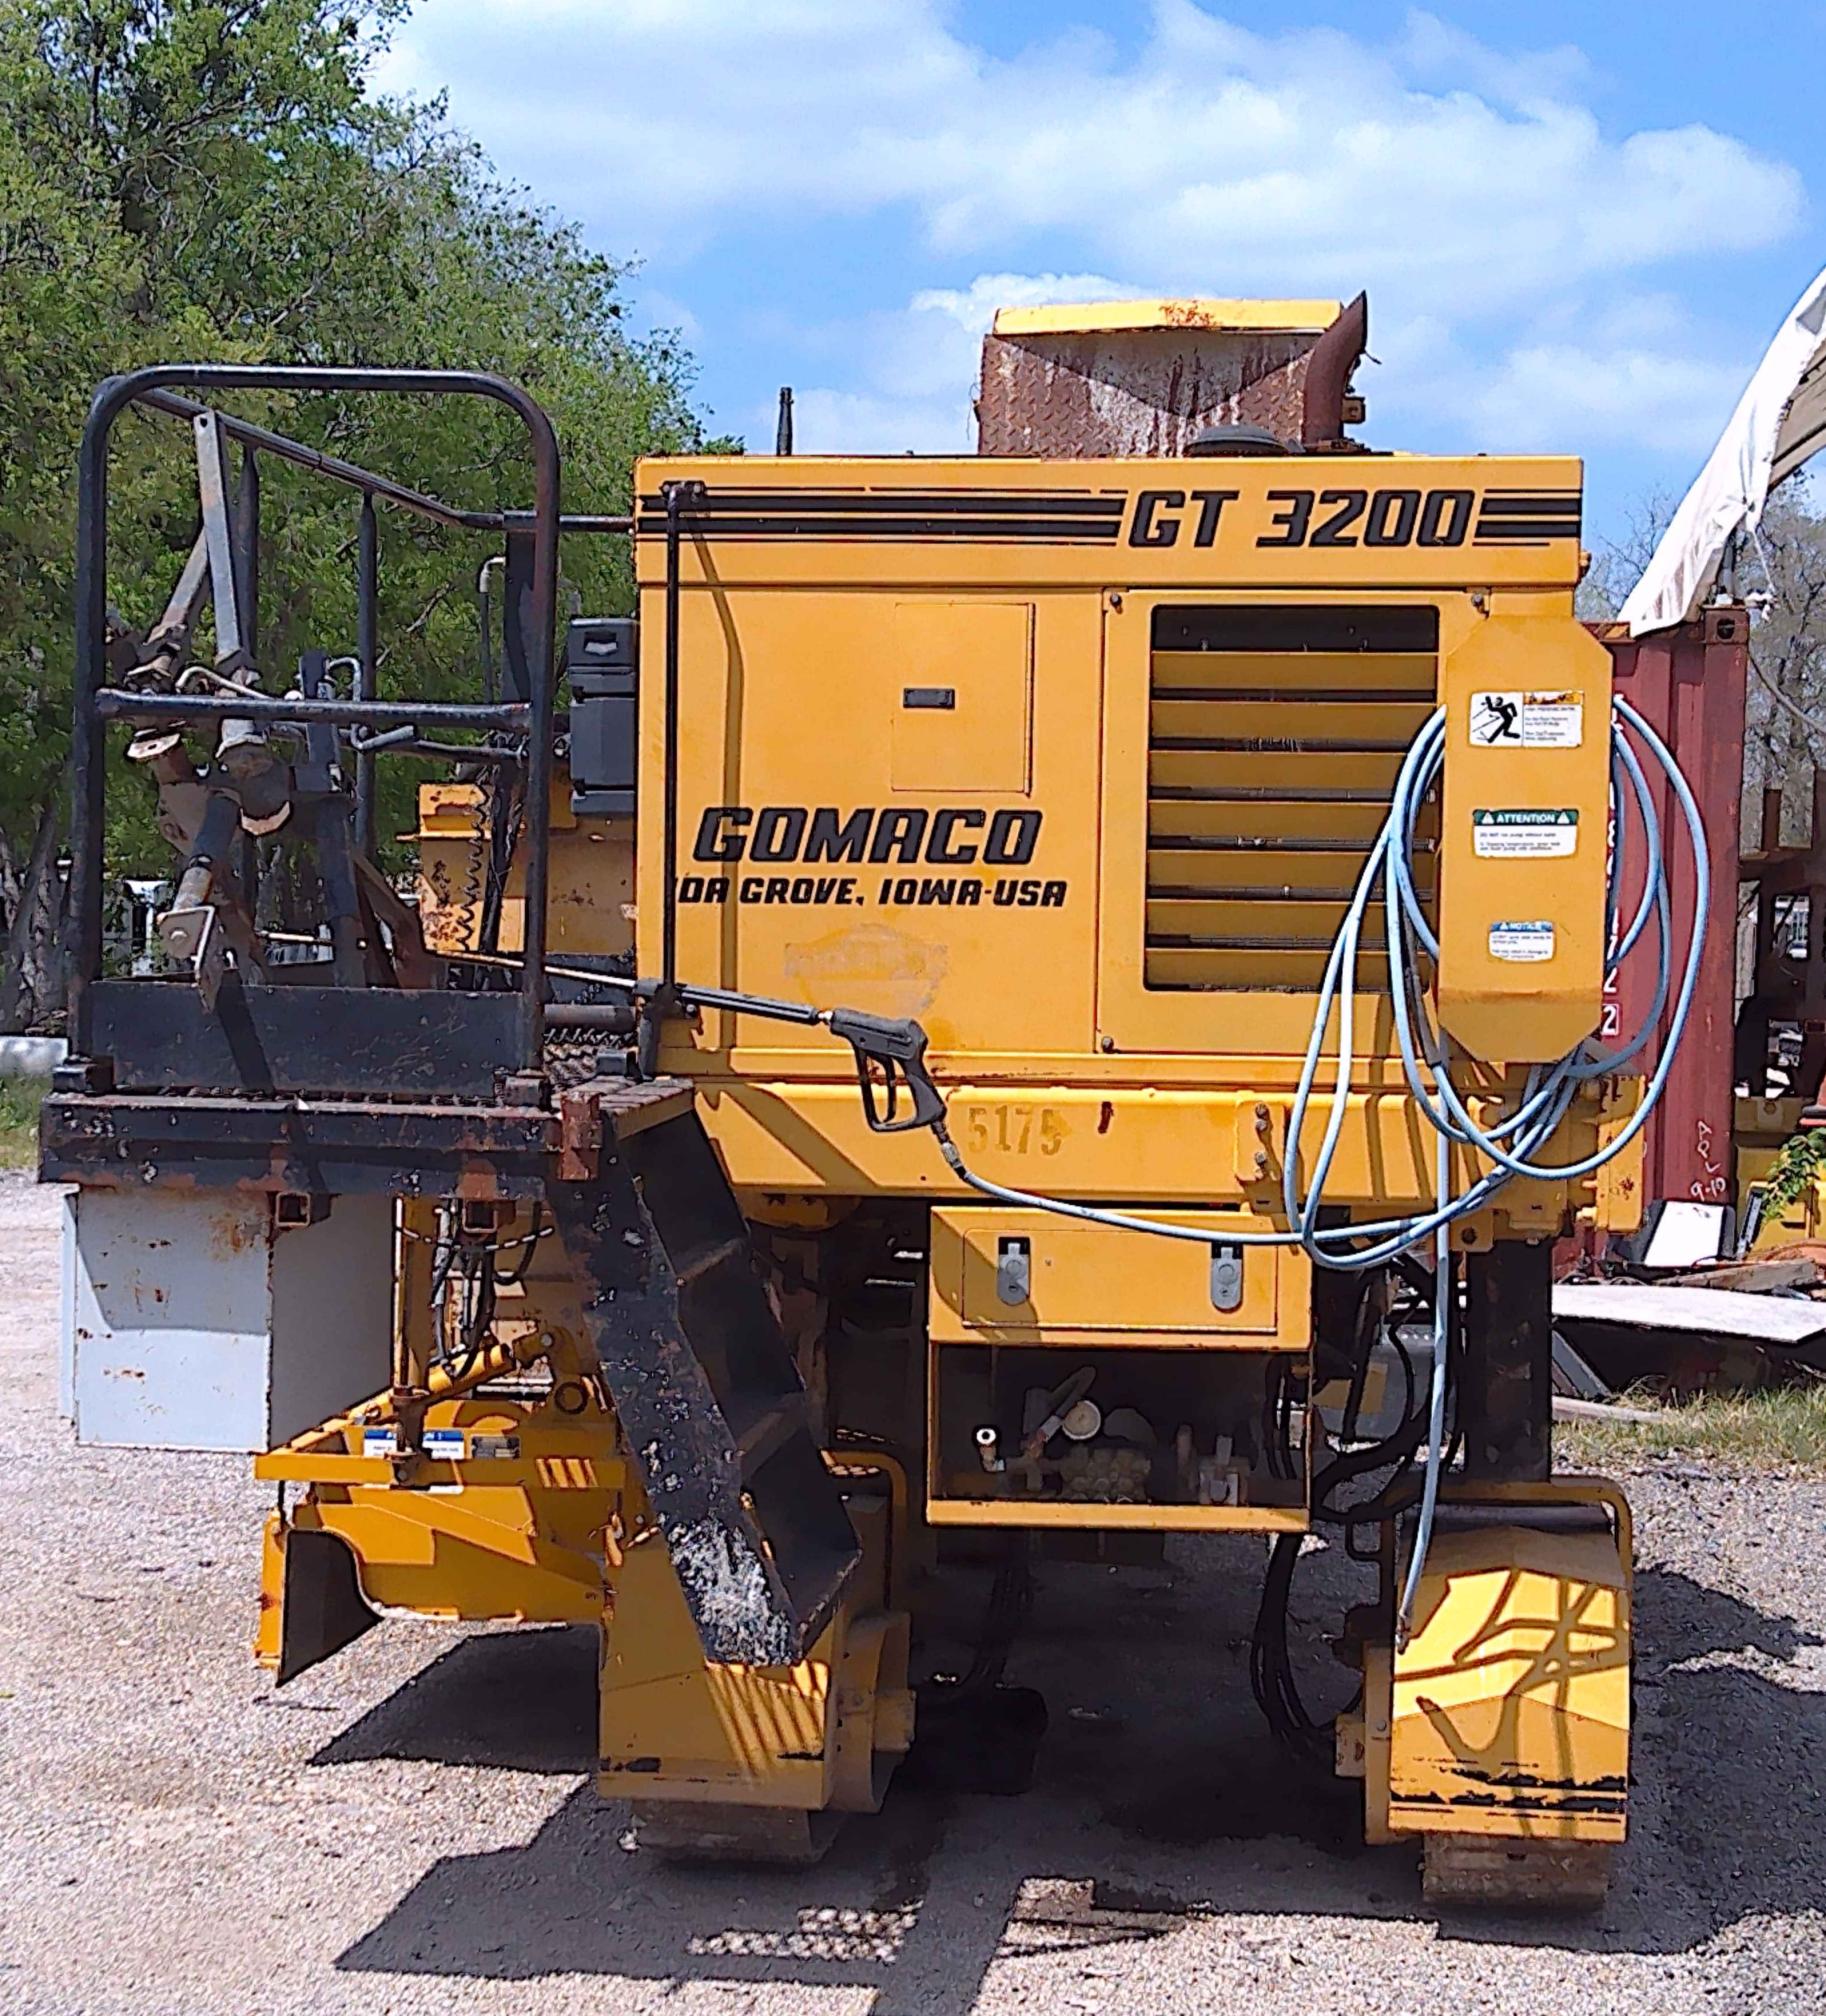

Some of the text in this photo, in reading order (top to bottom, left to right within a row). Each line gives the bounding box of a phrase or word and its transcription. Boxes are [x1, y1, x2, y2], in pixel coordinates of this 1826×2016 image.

[1128, 489, 1475, 548] GT 3200
[693, 807, 1043, 864] GOMACO
[1496, 813, 1555, 824] ATTENTION
[675, 876, 1067, 907] DA GROVE, IOWA-USA
[968, 1105, 1063, 1156] 5175
